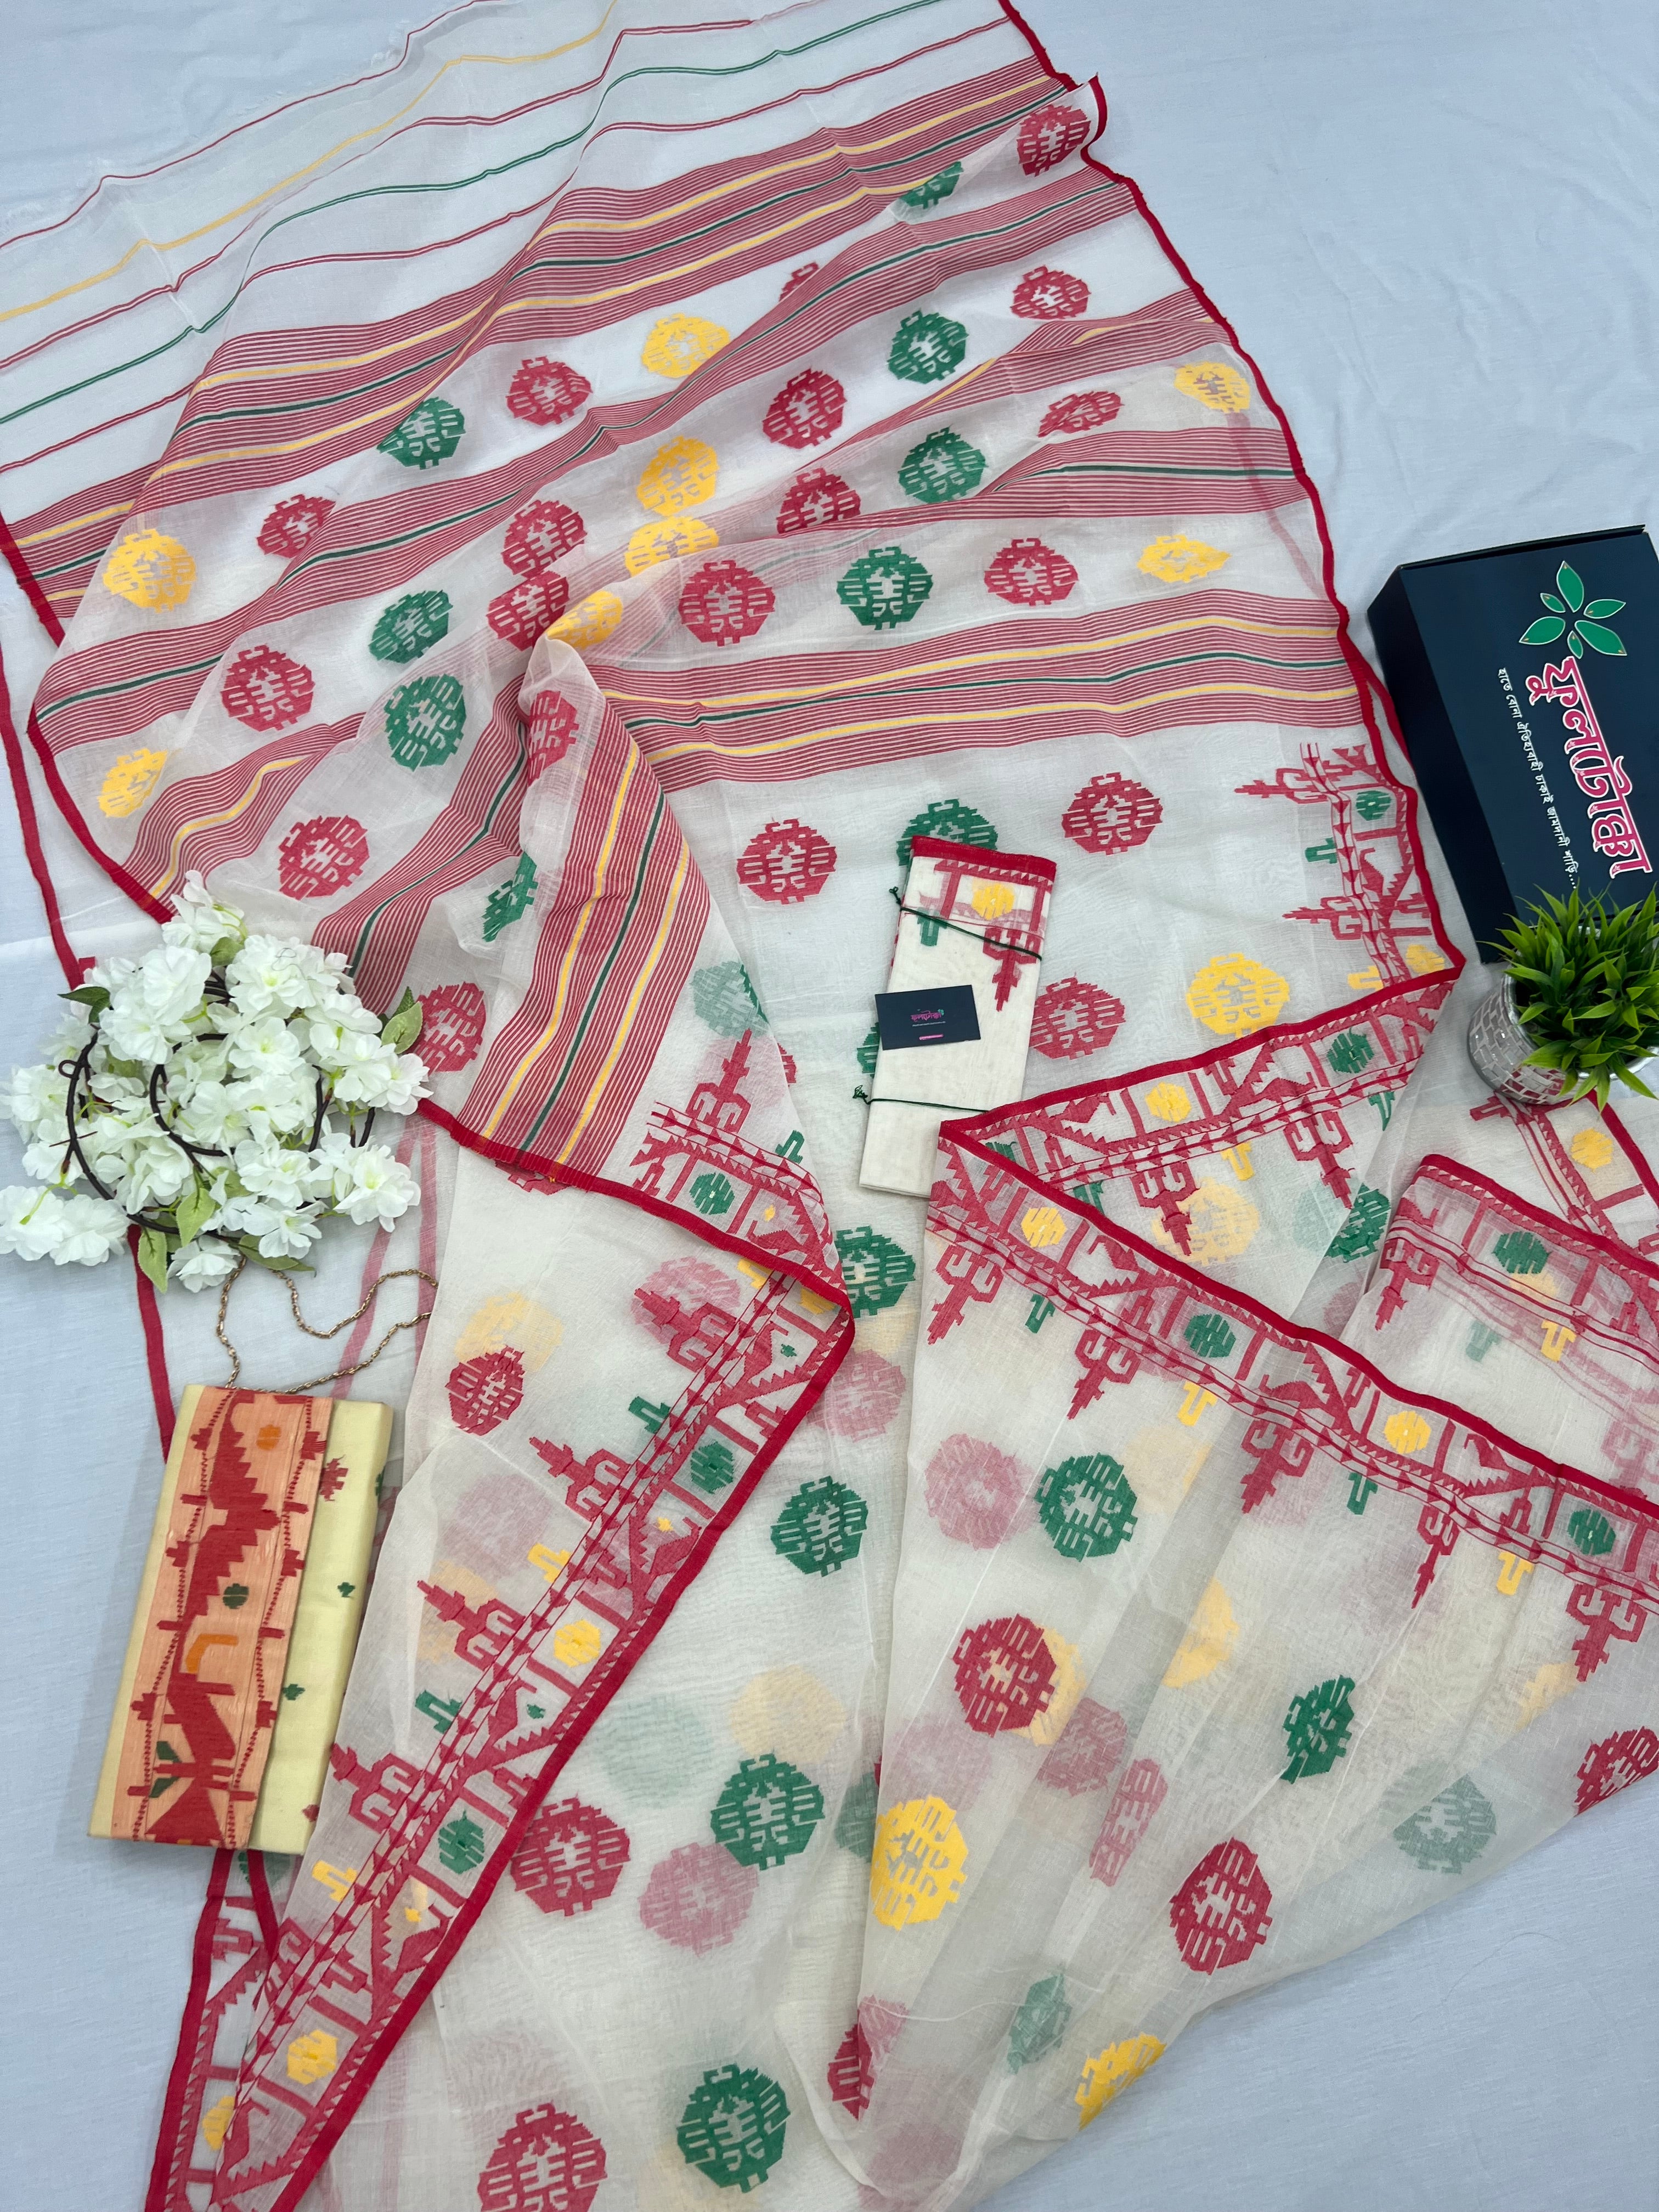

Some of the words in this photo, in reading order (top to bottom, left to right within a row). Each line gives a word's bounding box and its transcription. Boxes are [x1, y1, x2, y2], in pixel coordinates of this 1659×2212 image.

[1498, 668, 1513, 691] হাতে
[1506, 695, 1522, 719] বোনা
[1516, 721, 1544, 772] ঐতিহ্যবাহী
[1535, 774, 1555, 804] ঢাকাই
[1547, 805, 1570, 848] জামদানী
[1525, 656, 1652, 878] ফুলটোক্কা
